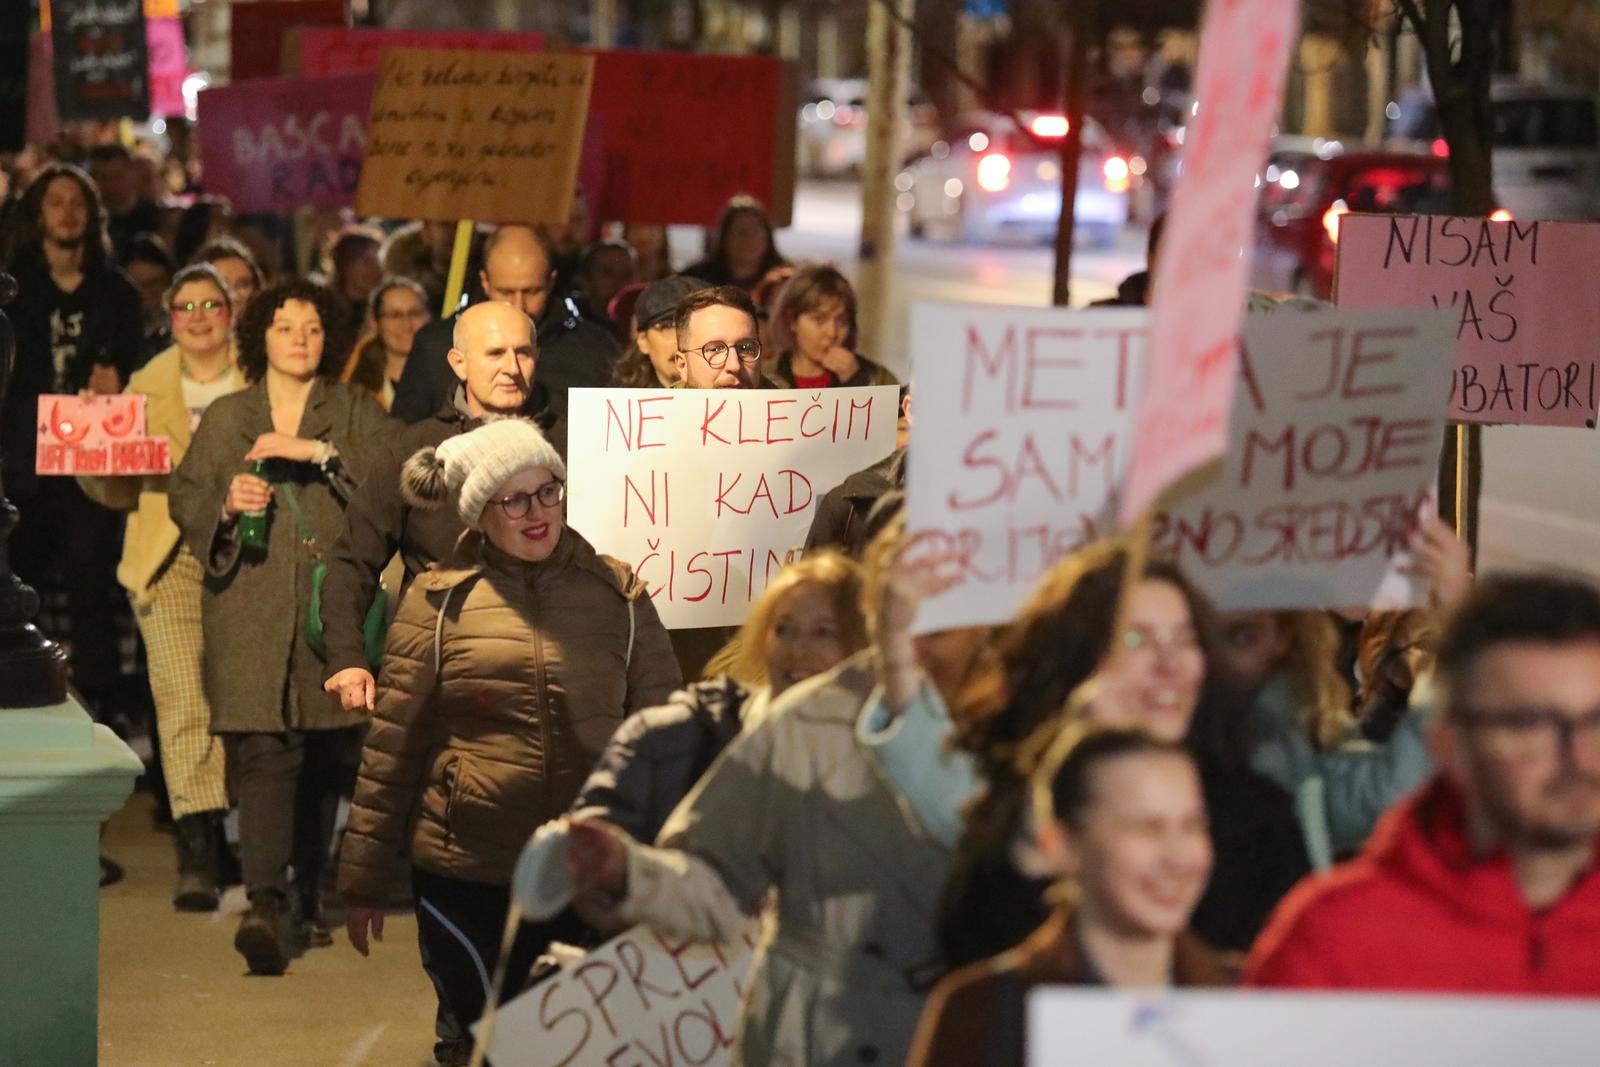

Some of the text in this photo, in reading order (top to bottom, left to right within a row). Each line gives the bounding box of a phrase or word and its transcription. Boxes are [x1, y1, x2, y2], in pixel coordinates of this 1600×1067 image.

[1383, 216, 1539, 269] NISAM
[957, 322, 1267, 416] MET
[1295, 325, 1420, 402] JE
[1448, 361, 1596, 429] BATOR!
[606, 392, 873, 451] NE KLEČIM
[948, 417, 1434, 511] SAM MOJE
[624, 470, 813, 528] NI KAD
